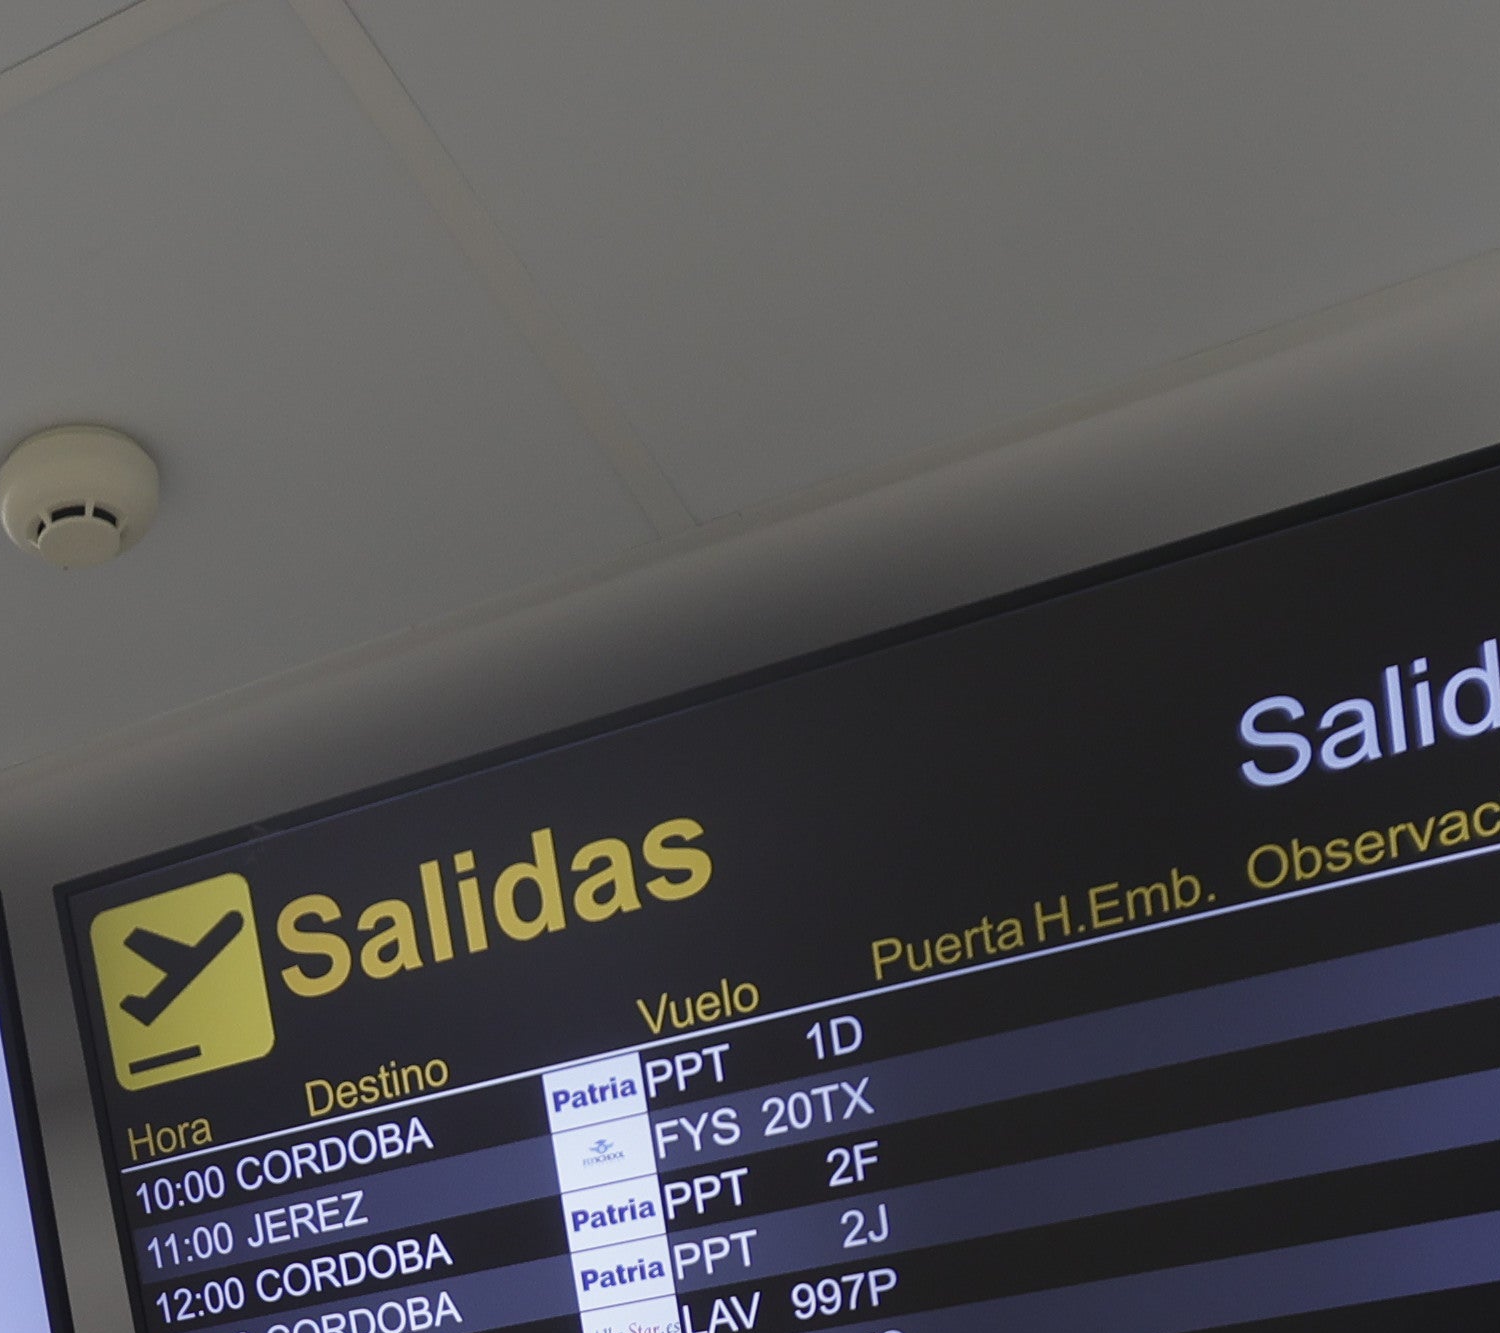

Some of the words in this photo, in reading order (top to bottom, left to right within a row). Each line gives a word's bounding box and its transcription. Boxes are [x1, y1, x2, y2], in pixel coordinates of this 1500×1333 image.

[276, 817, 714, 998] Salidas
[127, 1117, 214, 1161] Hora
[305, 1056, 449, 1118] Destino
[636, 977, 760, 1035] Vuelo
[870, 908, 1025, 981] Puerta
[1033, 866, 1217, 943] H.Emb.
[135, 1165, 226, 1214] 10:00
[236, 1116, 434, 1191] CORDOBA
[645, 1042, 730, 1099] PPT
[806, 1014, 864, 1061] 1D
[552, 1075, 638, 1113] Patria
[146, 1221, 234, 1269] 11:00
[247, 1190, 369, 1249] JEREZ
[654, 1106, 741, 1160] FYS
[761, 1076, 876, 1137] 20TX
[155, 1276, 245, 1324] 12:00
[256, 1232, 454, 1303] CORDOBA
[663, 1167, 749, 1220] PPT
[825, 1140, 879, 1188] 2F
[572, 1197, 657, 1232] Patria
[580, 1257, 666, 1292] Patria
[673, 1229, 758, 1281] PPT
[839, 1203, 890, 1249] 2J
[790, 1267, 898, 1321] 997P
